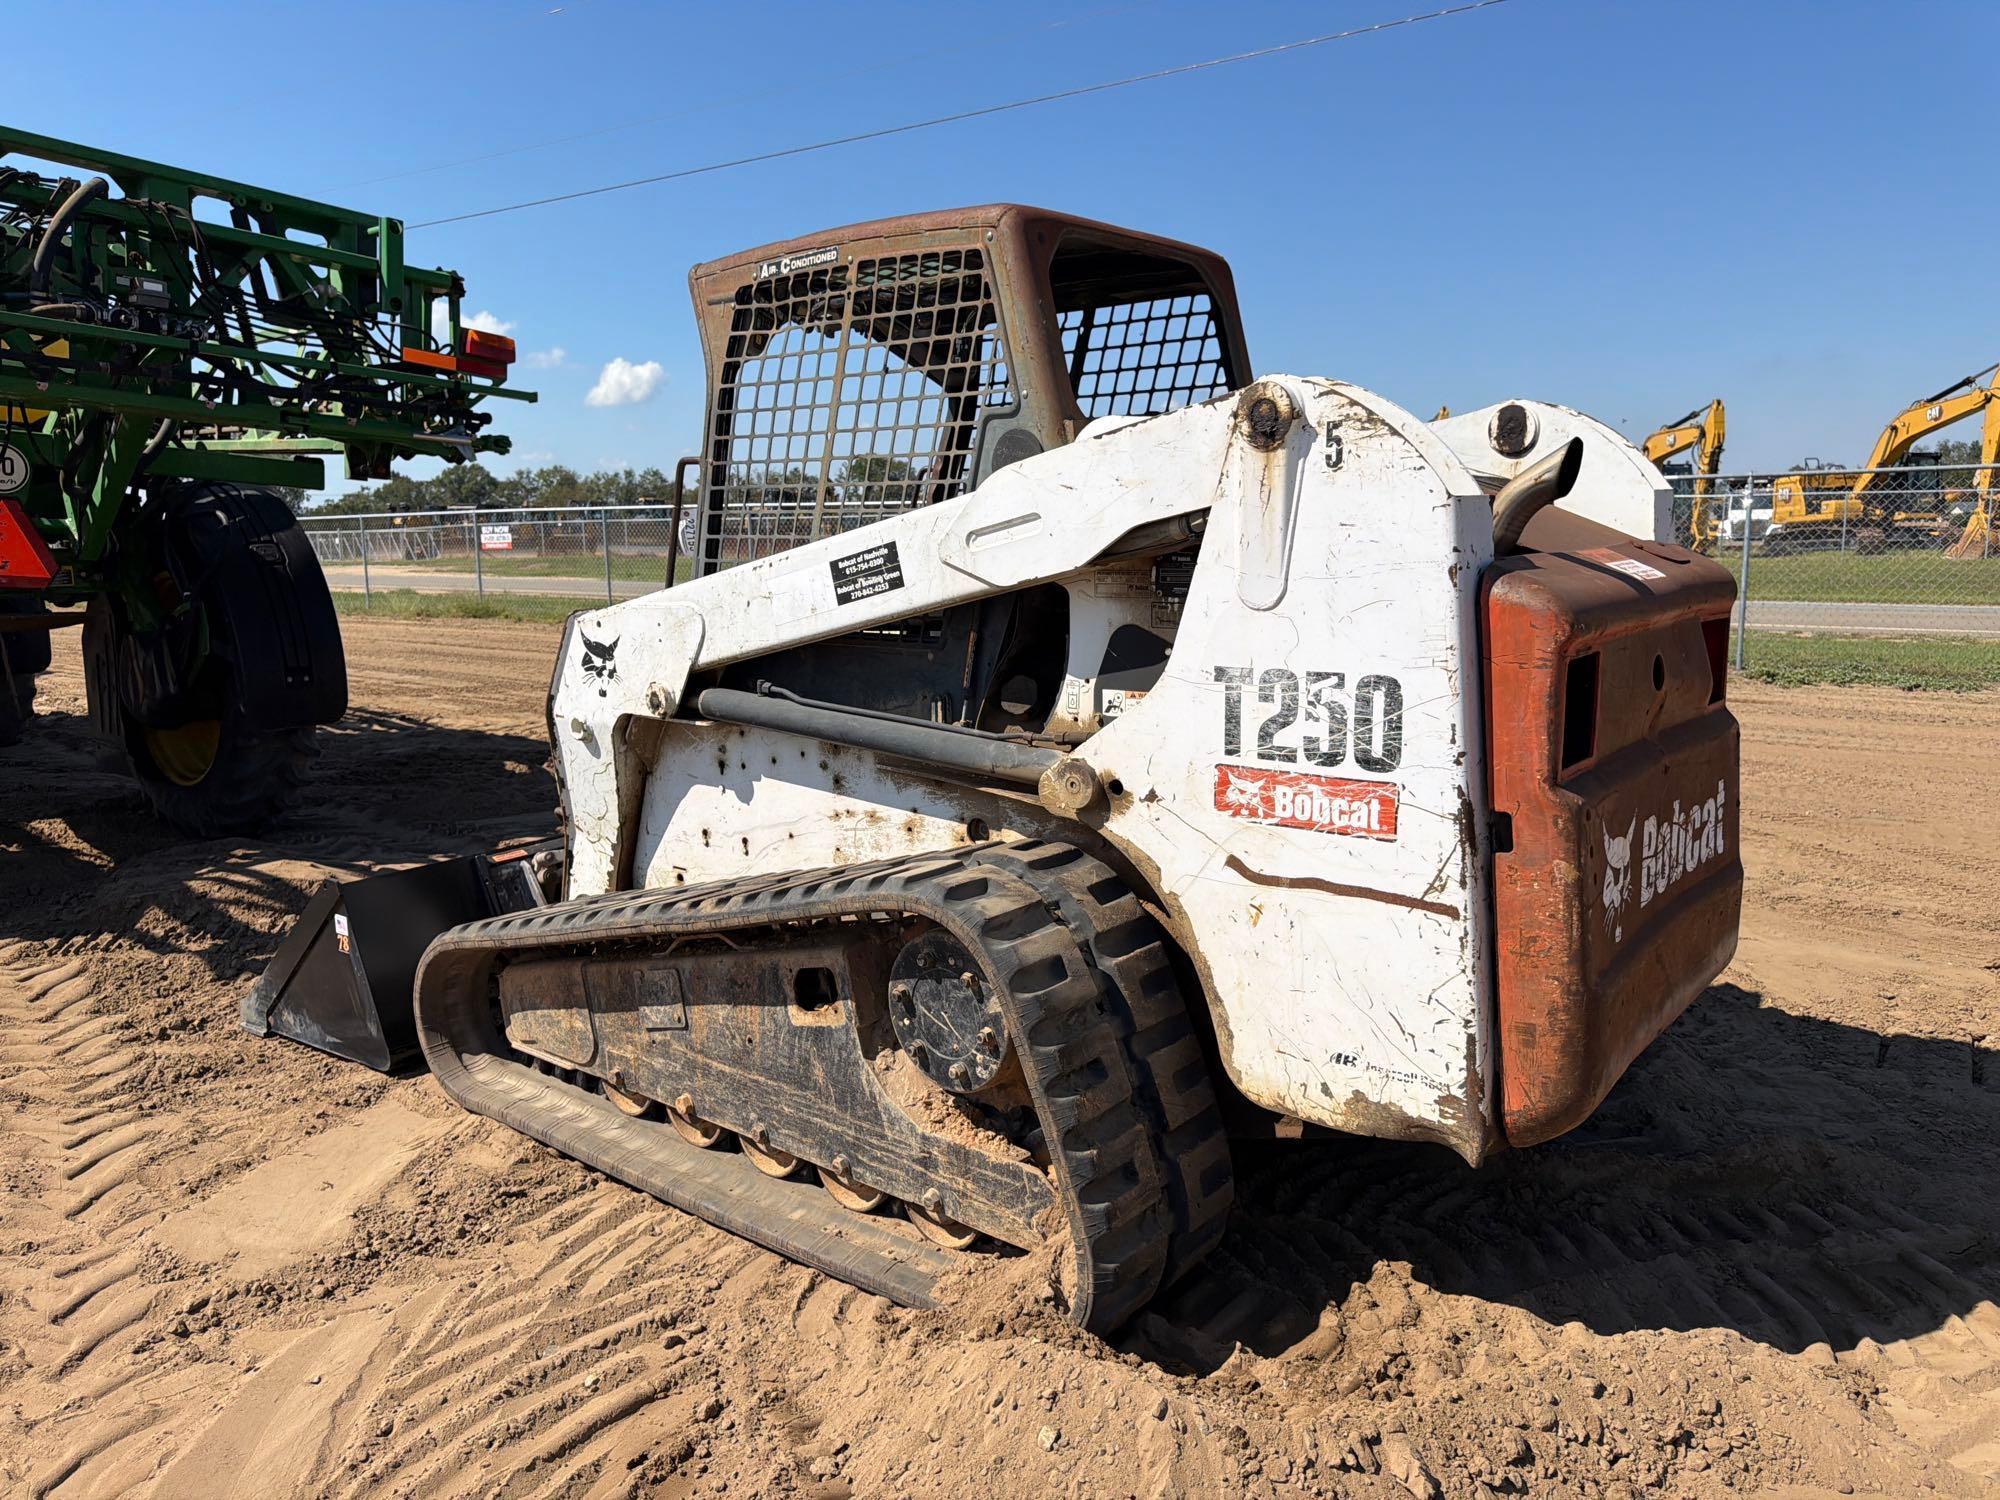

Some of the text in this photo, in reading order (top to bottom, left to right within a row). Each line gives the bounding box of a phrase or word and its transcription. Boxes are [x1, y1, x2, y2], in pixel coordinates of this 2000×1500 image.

[781, 250, 837, 274] CONDITIONED
[1927, 406, 1940, 421] CAT
[1325, 420, 1343, 468] 5
[838, 557, 857, 569] Bobcat
[837, 584, 855, 595] Bobcat
[1214, 666, 1404, 773] T250
[1275, 784, 1381, 831] Bobcat
[1641, 779, 1726, 909] Bobcat
